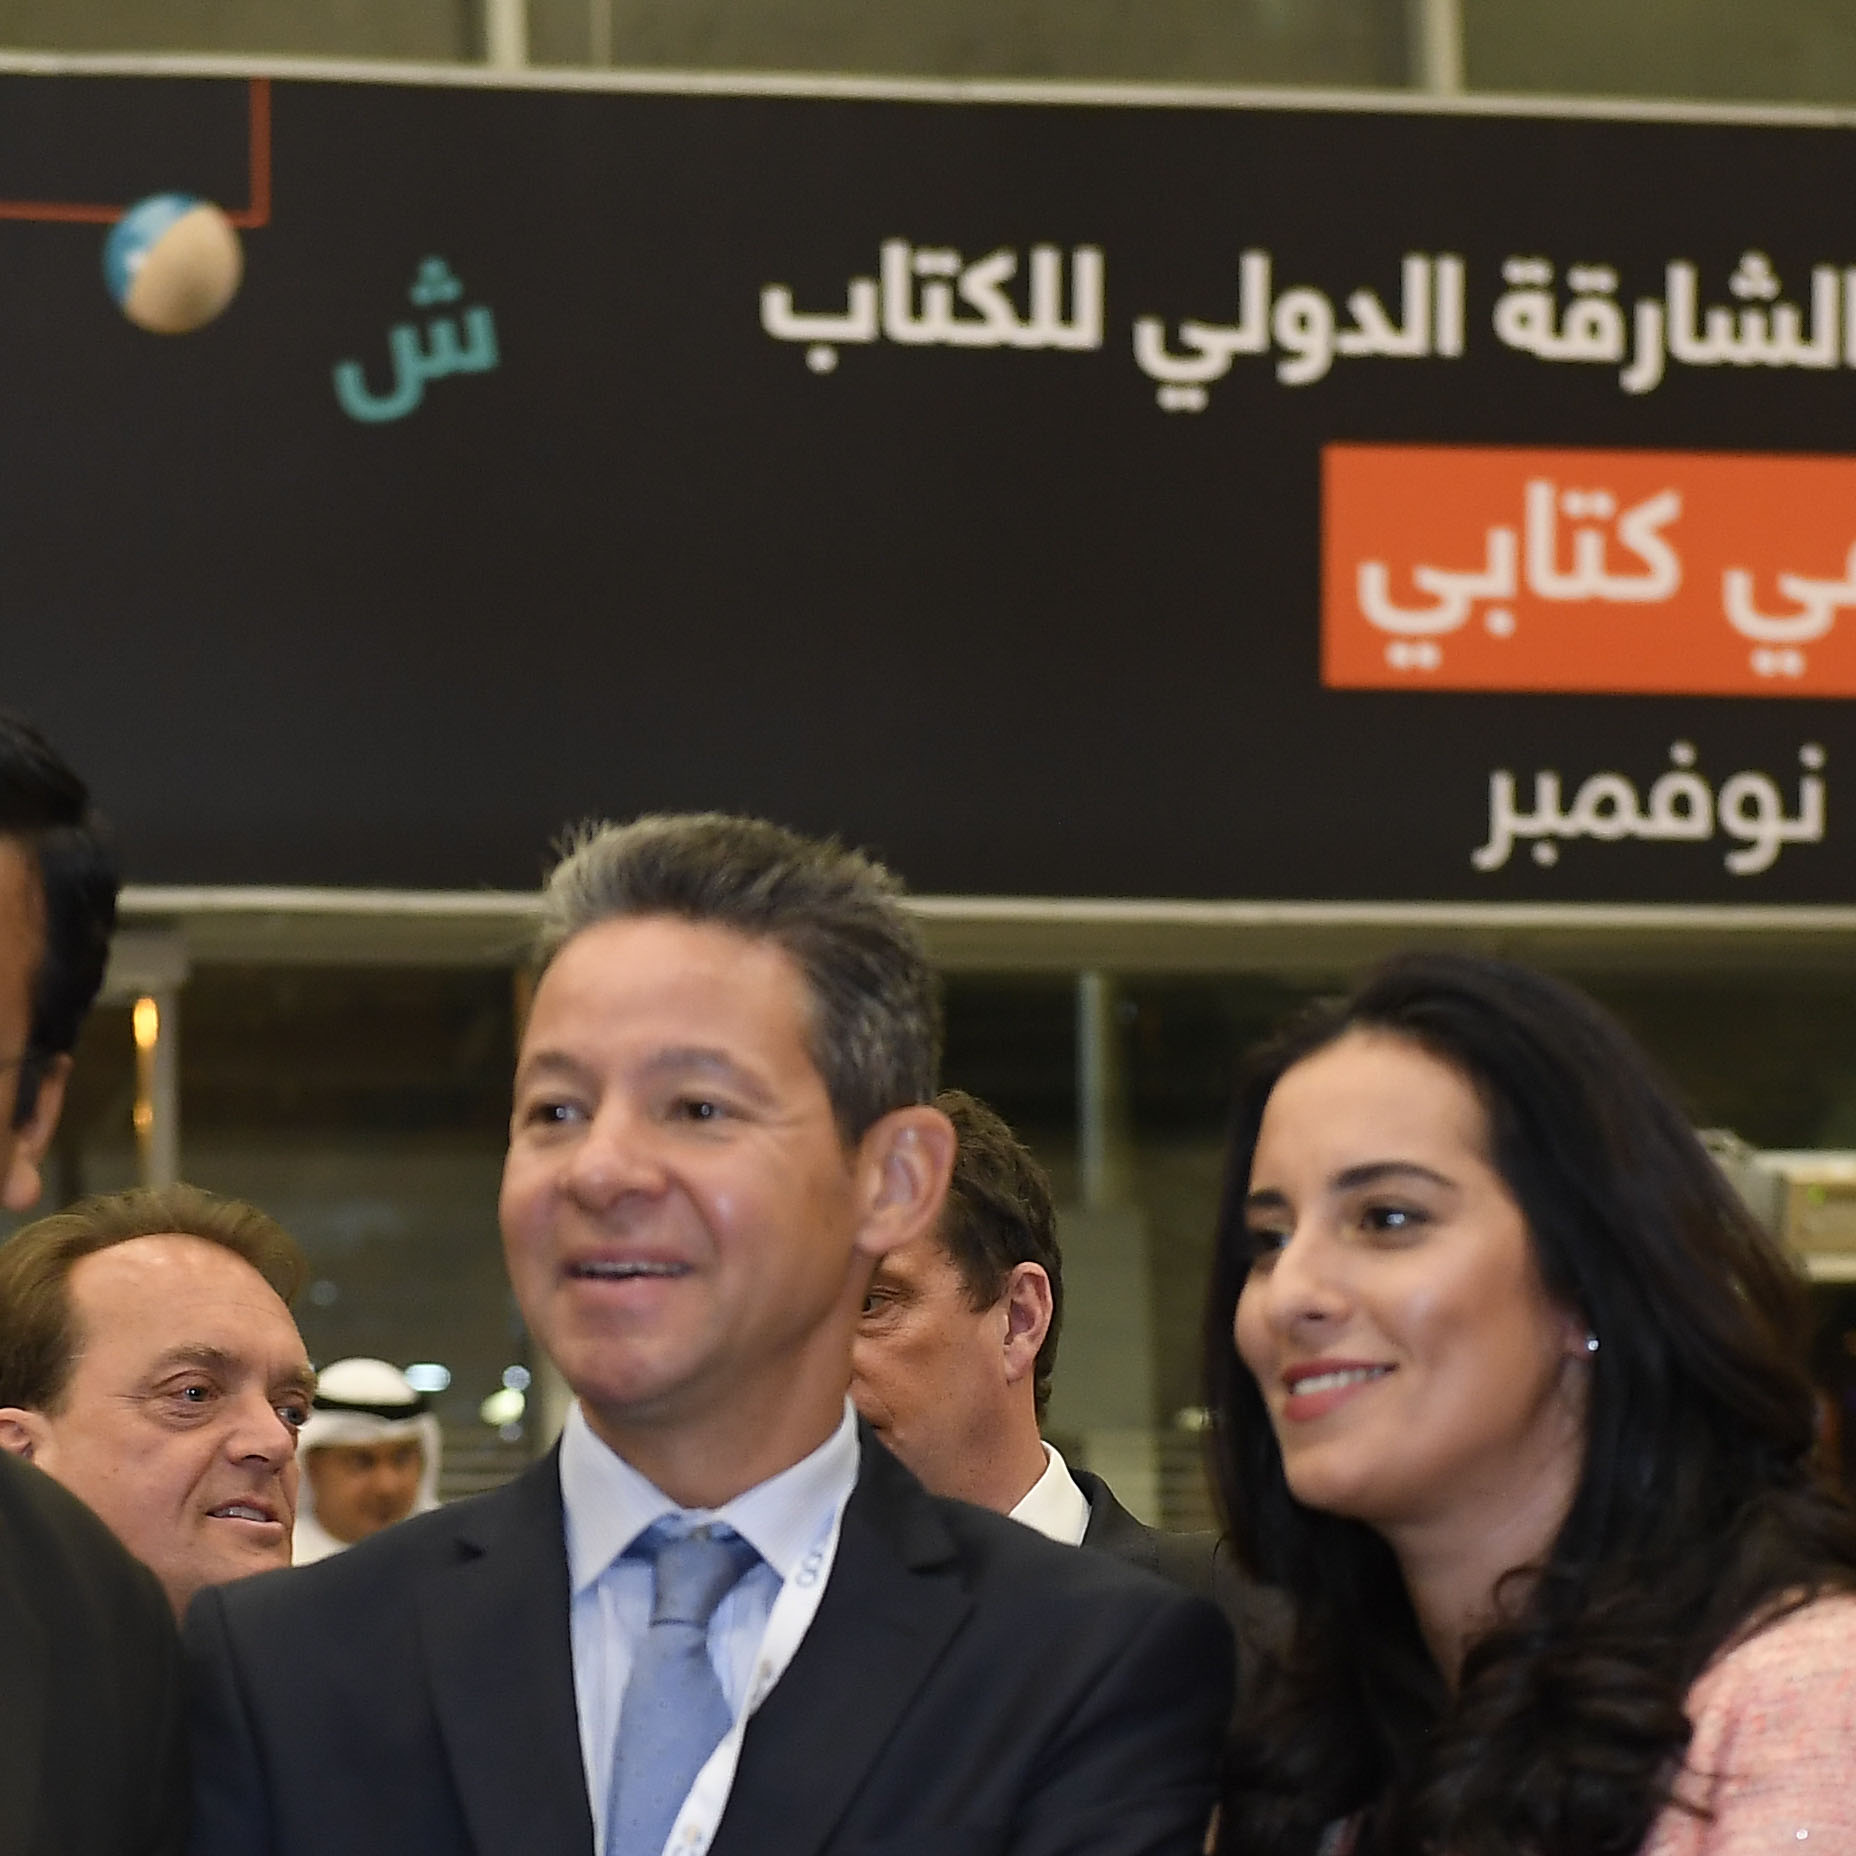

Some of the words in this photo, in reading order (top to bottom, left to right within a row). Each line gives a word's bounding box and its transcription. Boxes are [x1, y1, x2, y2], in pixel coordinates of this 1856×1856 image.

[332, 256, 500, 422] ش
[760, 241, 1102, 372] للكتاب
[1132, 252, 1463, 410] الدولي
[1356, 480, 1682, 670] كتابي
[1472, 743, 1824, 874] نوفمبر
